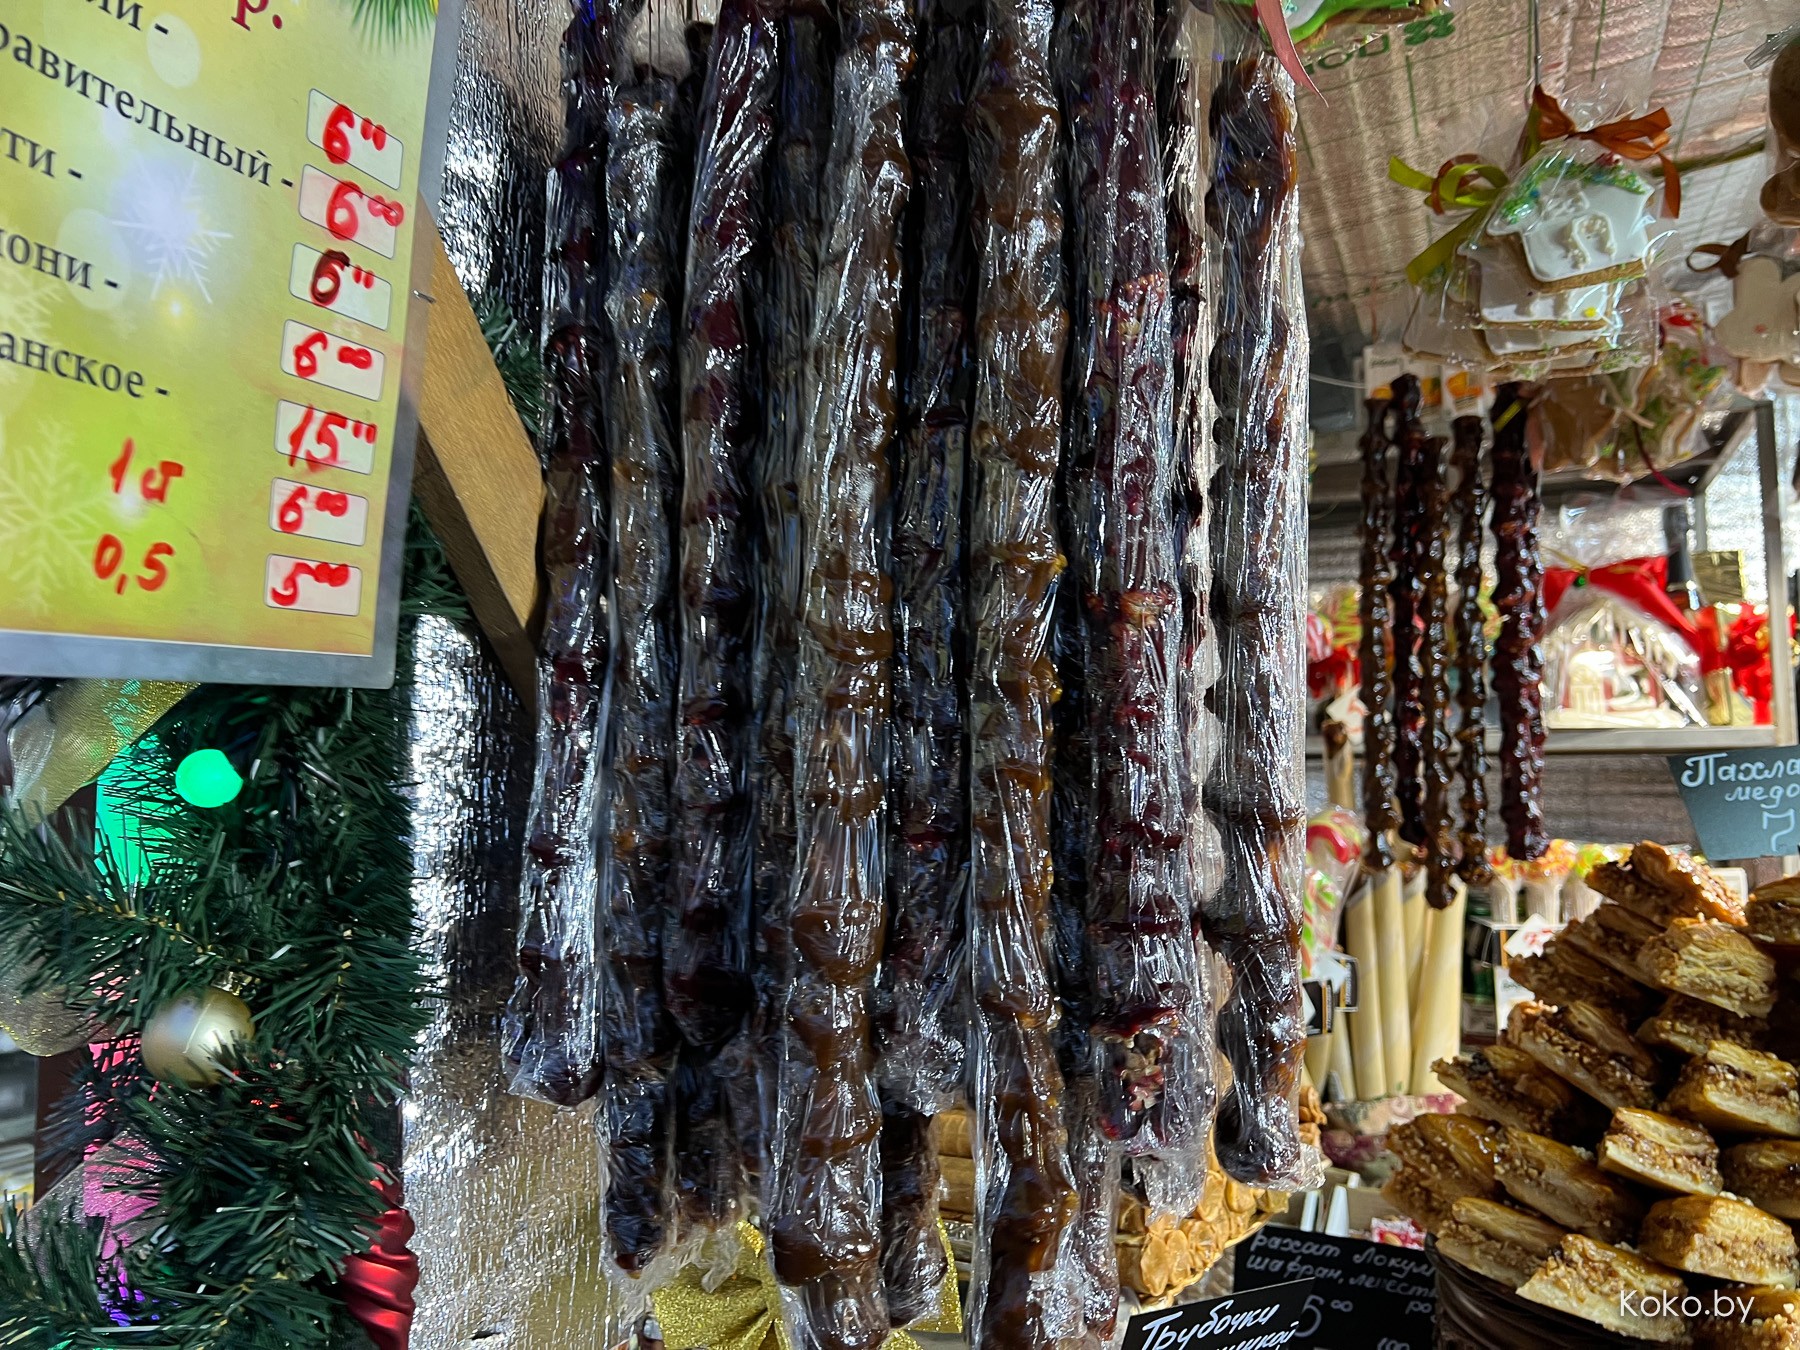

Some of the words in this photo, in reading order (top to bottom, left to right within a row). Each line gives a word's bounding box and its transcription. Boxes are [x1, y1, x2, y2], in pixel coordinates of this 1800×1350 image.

[0, 229, 94, 291] они
[93, 533, 175, 595] 0,5
[1681, 752, 1800, 787] Пахла
